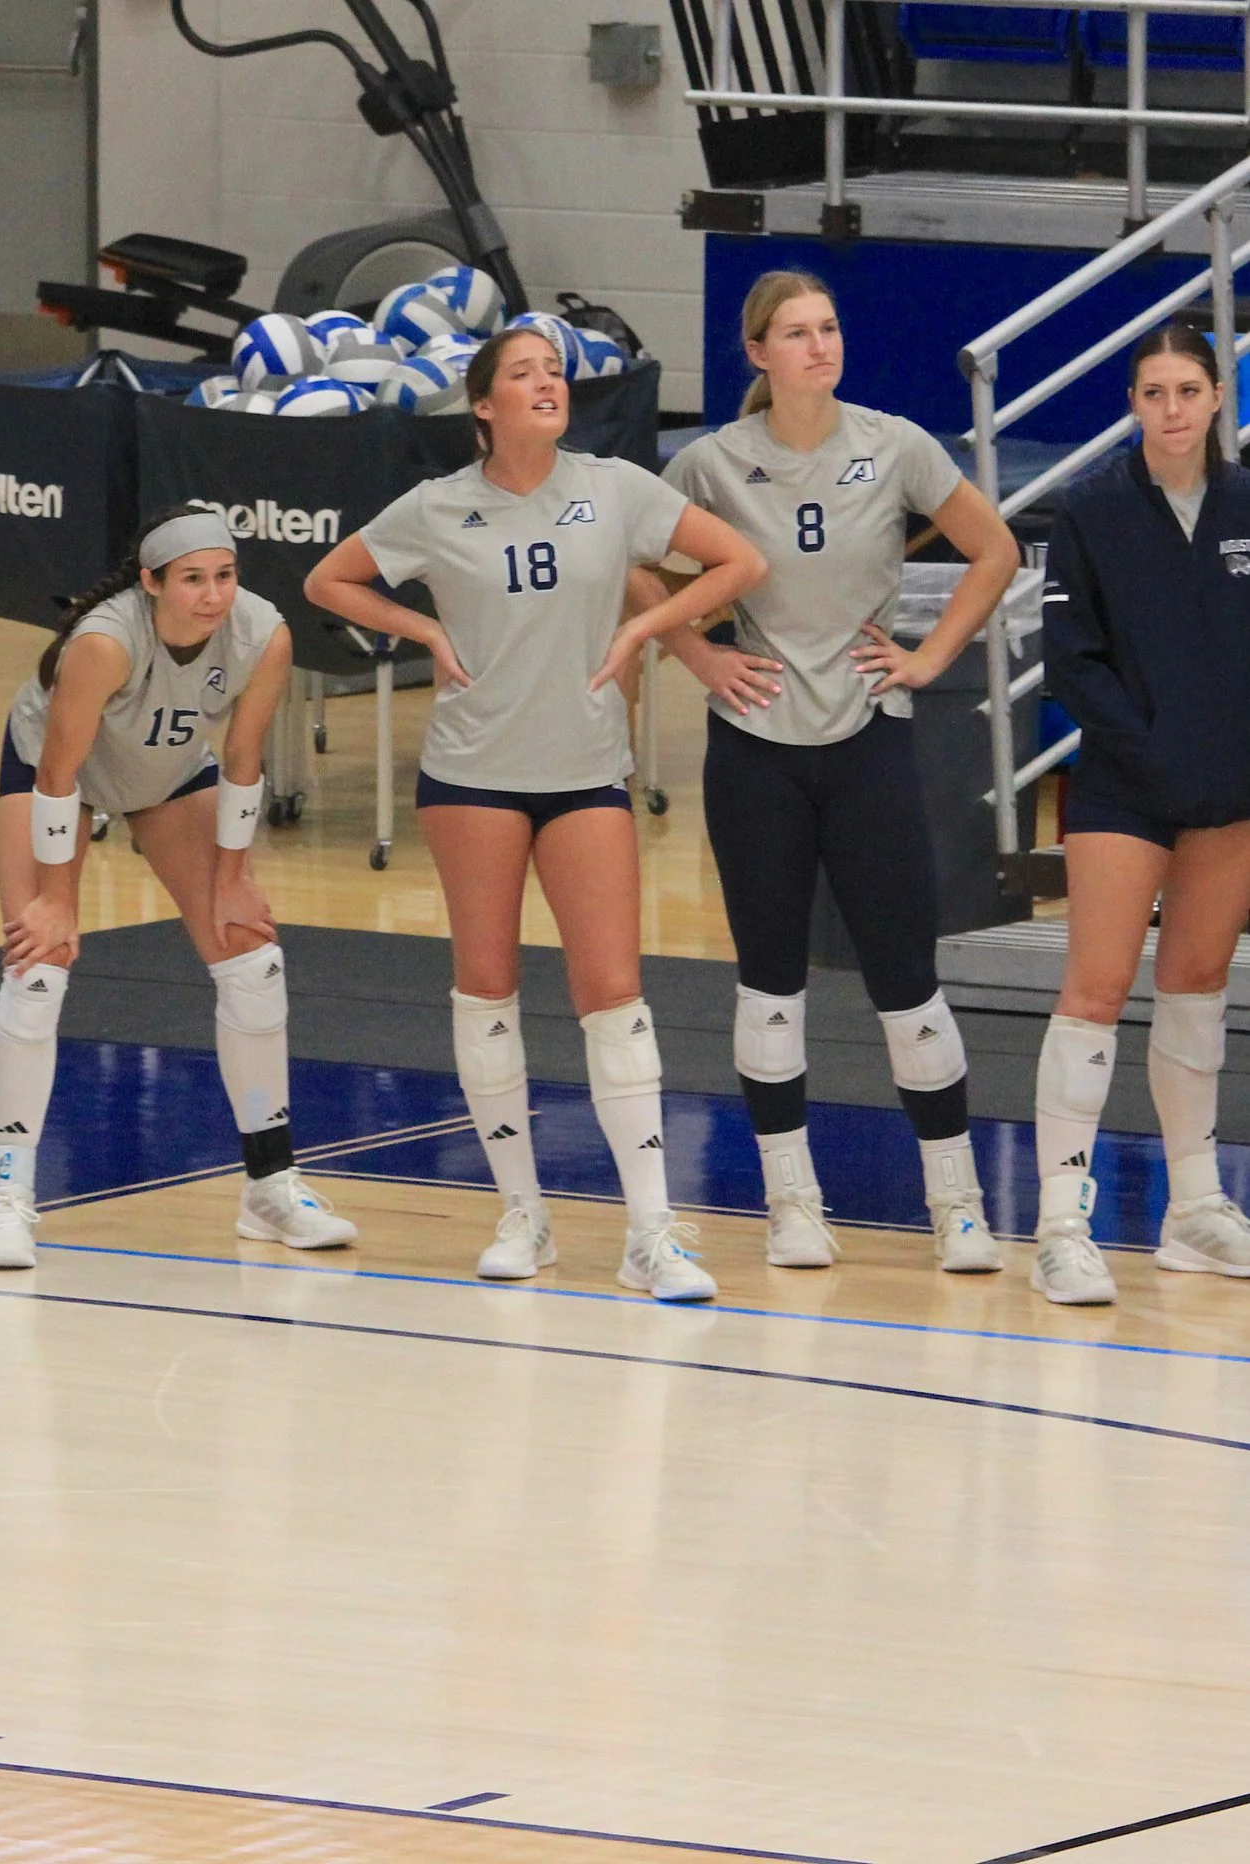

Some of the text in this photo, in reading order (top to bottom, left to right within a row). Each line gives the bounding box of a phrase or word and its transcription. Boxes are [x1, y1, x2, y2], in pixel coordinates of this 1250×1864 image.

[796, 502, 825, 553] 8
[503, 541, 558, 594] 18
[144, 706, 200, 748] 15
